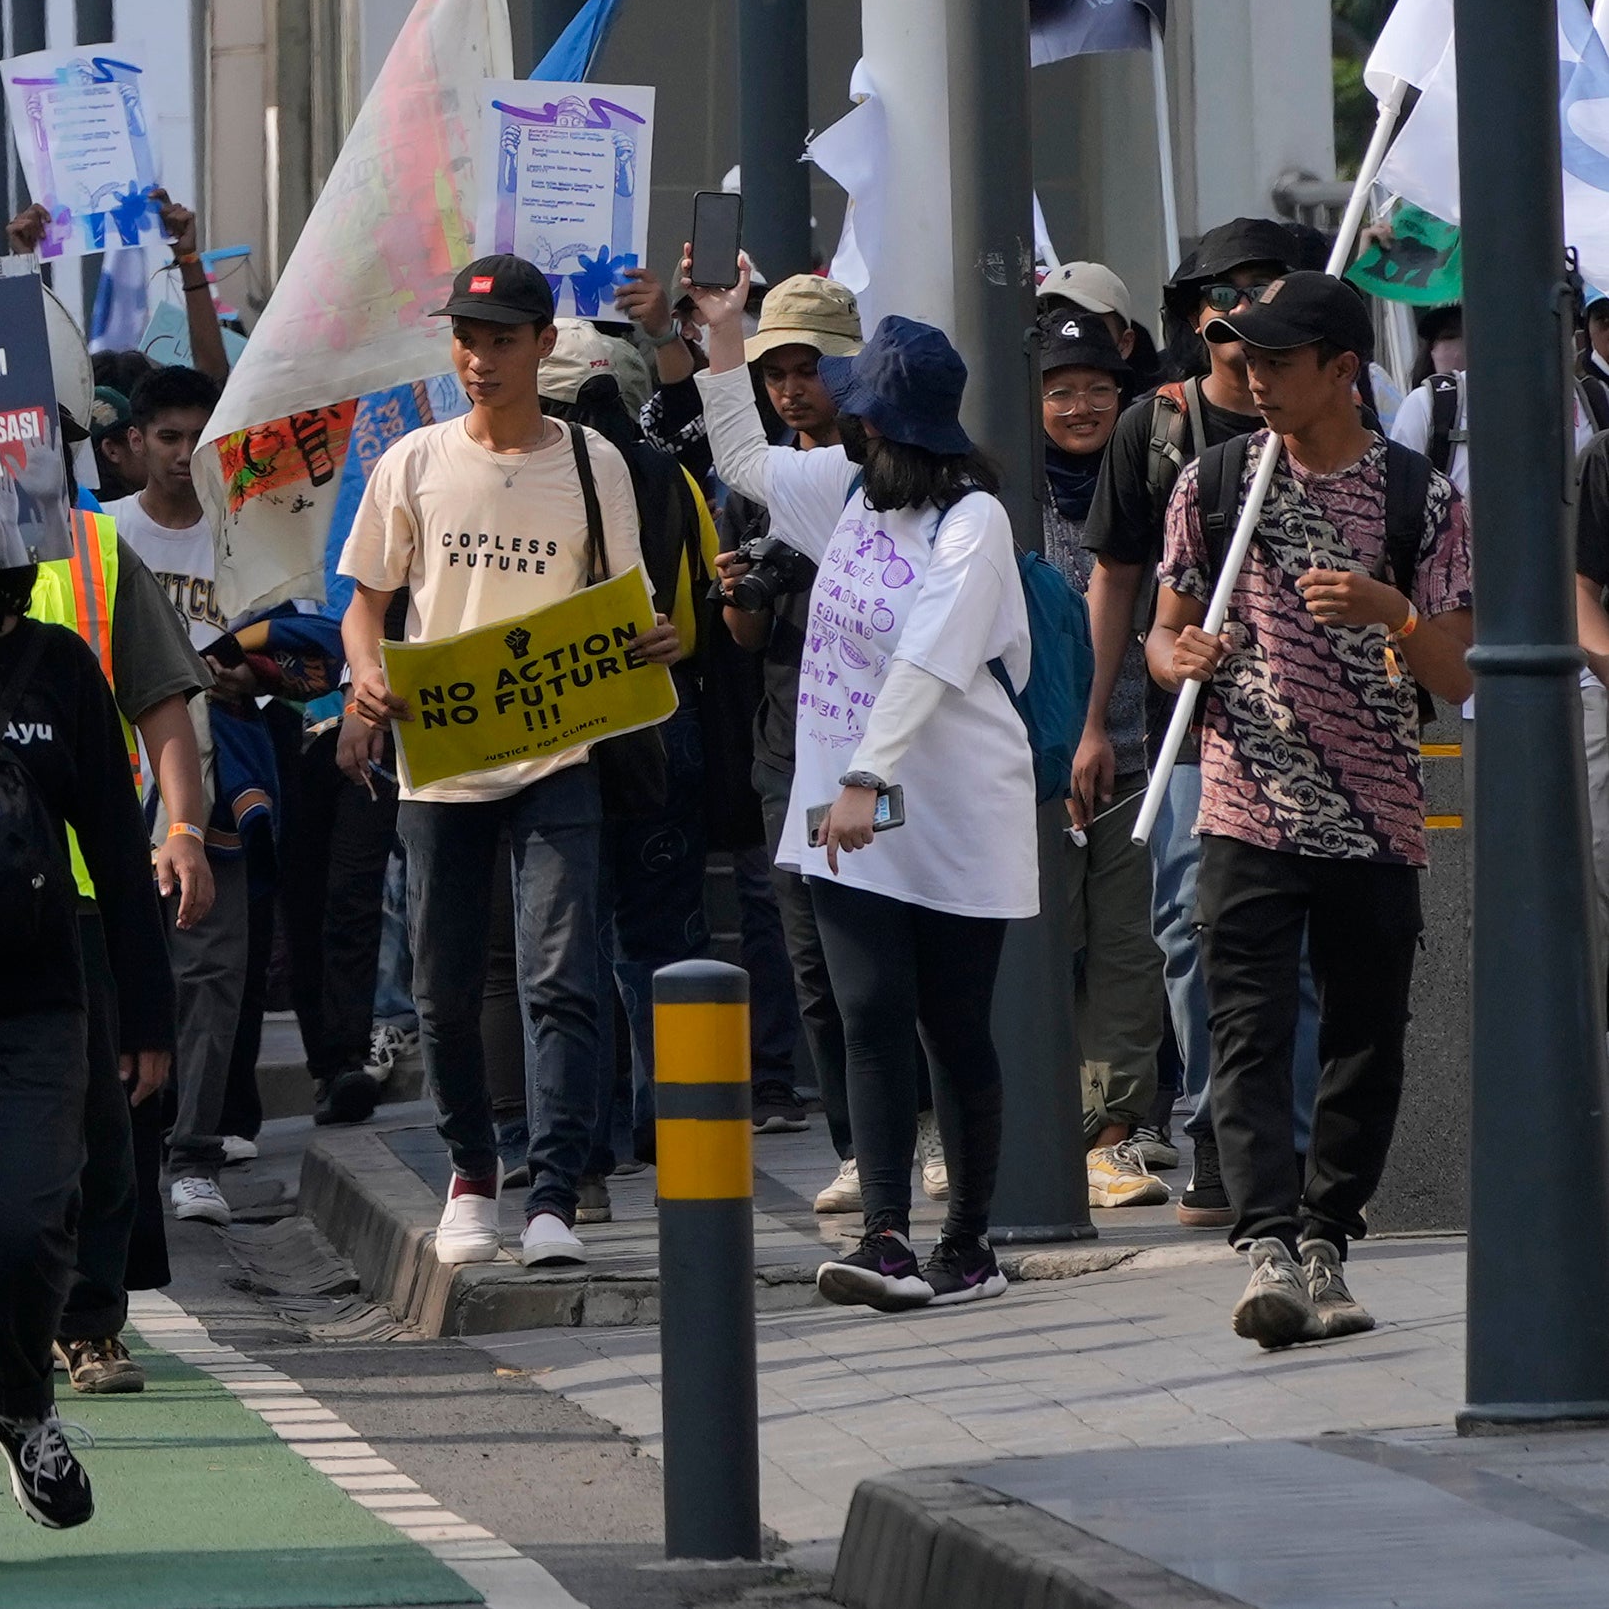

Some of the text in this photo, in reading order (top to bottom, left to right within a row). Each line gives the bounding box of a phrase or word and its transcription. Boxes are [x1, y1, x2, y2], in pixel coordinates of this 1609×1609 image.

[441, 532, 558, 557] COPLESS
[449, 552, 546, 575] FUTURE
[419, 621, 639, 706] NO ACTION
[422, 649, 649, 730] NO FUTURE
[523, 703, 562, 733] !!!
[484, 715, 609, 762] JUSTICE FOR CLIMATE
